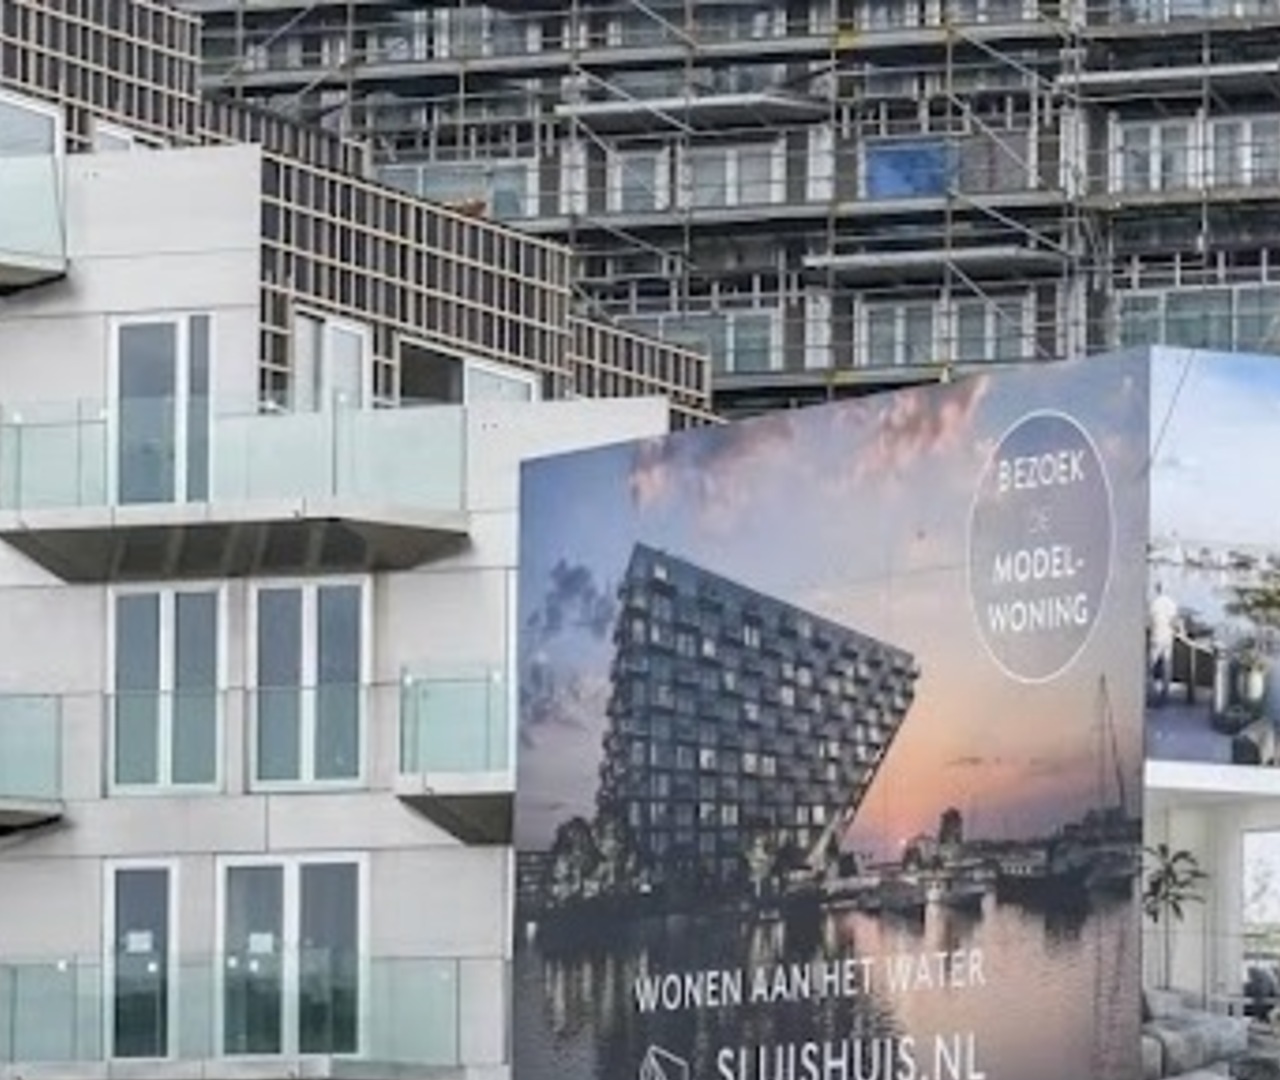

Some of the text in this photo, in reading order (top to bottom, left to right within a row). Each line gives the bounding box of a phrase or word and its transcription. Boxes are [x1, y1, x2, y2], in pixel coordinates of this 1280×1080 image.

[999, 451, 1085, 492] BEZOEK
[992, 546, 1085, 583] MODEL-
[988, 594, 1089, 632] WONING
[635, 949, 986, 1013] WONEN AAN HET WATER
